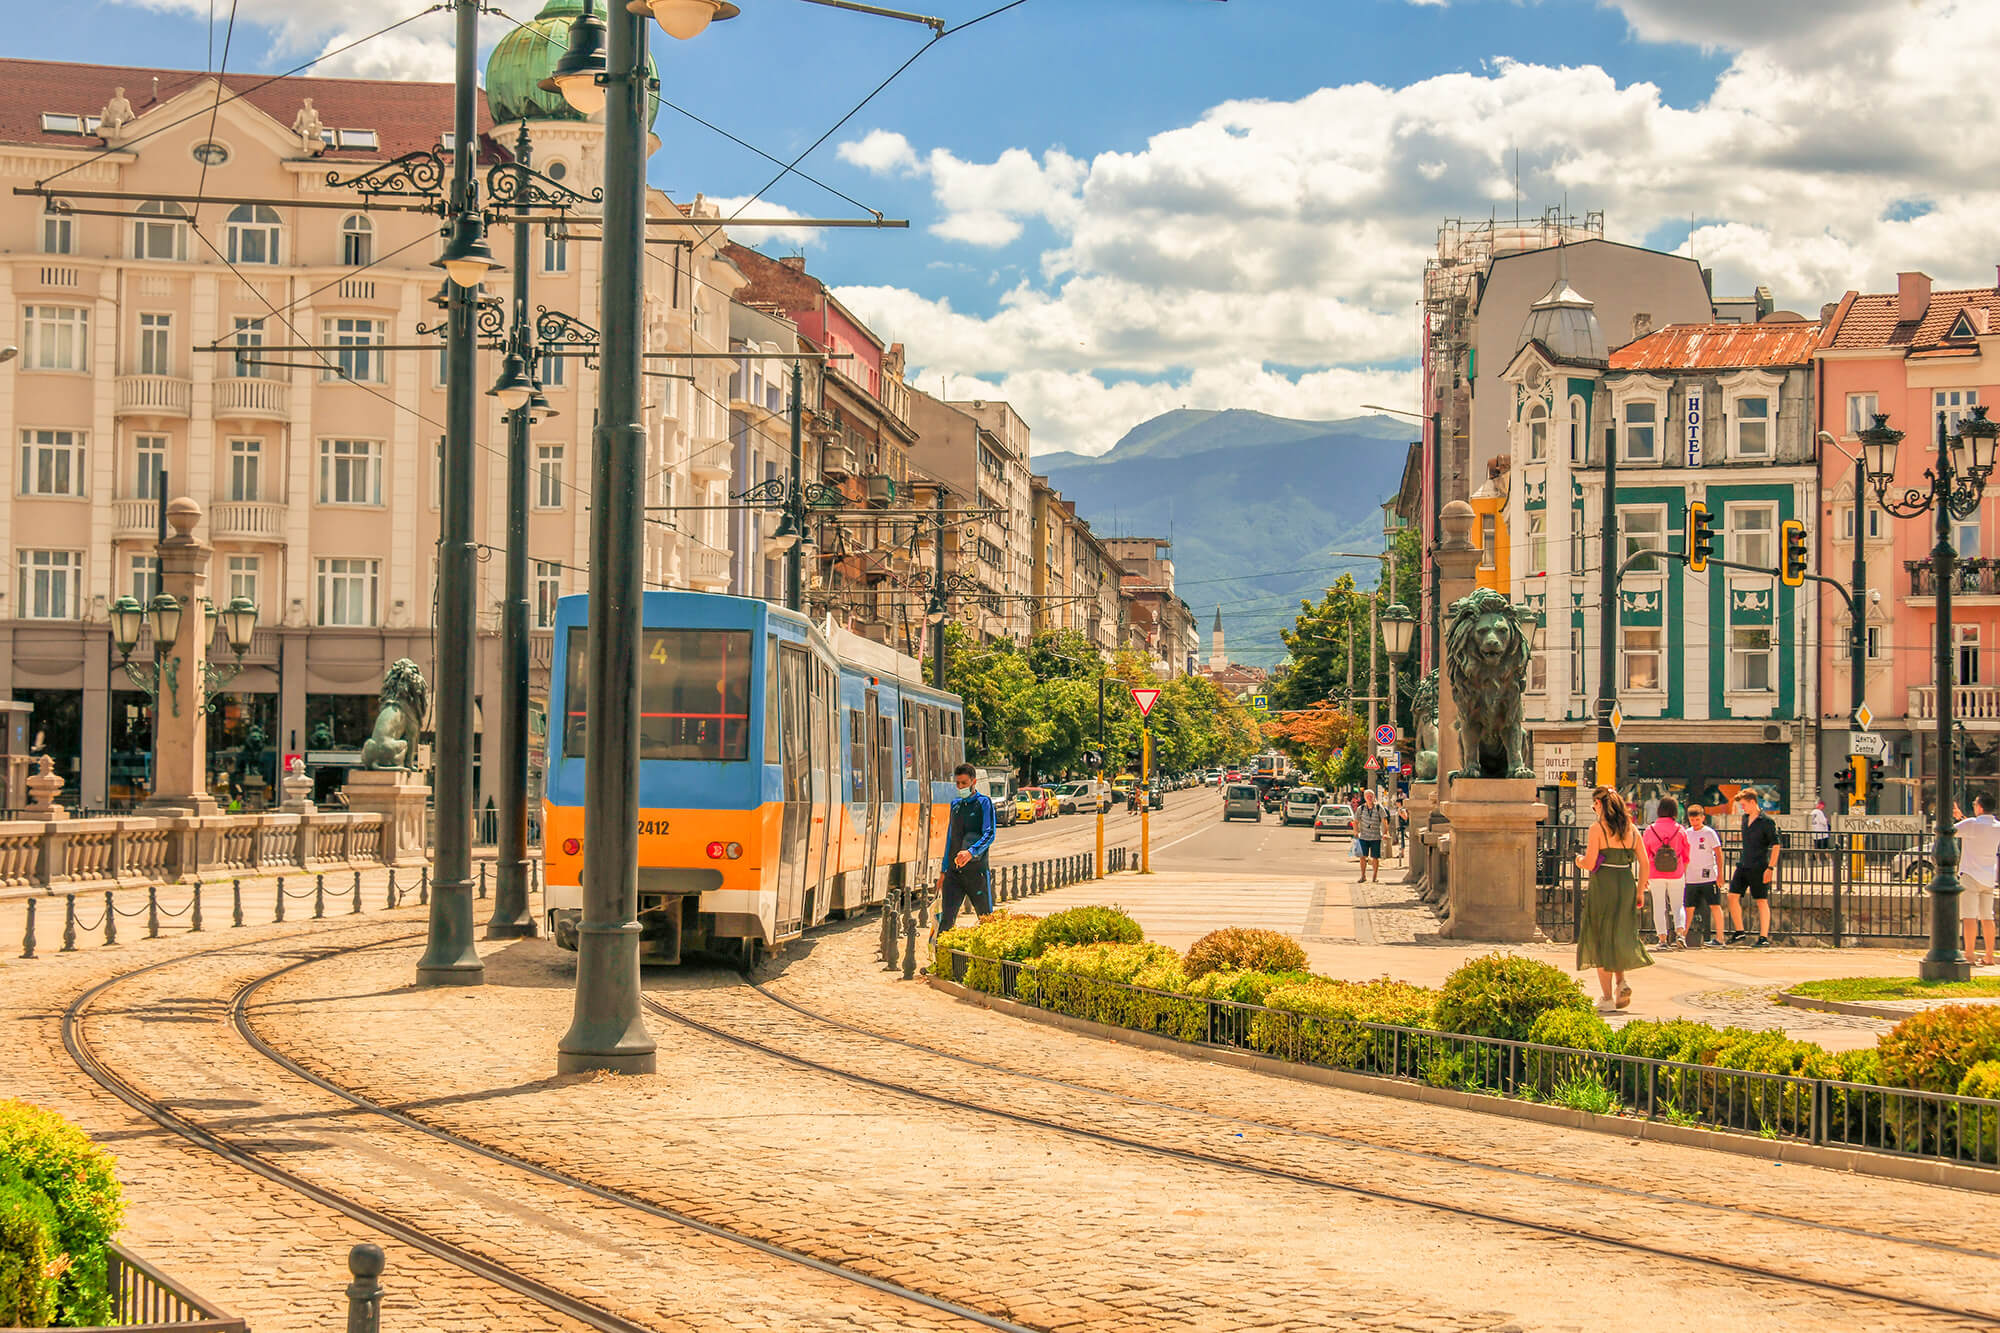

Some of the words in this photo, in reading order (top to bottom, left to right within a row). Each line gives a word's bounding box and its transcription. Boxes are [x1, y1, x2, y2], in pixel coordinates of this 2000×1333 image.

[1688, 397, 1700, 467] HOTEL
[650, 639, 667, 665] 4
[1856, 744, 1874, 753] Centre
[1546, 758, 1569, 767] OUTLET
[638, 820, 669, 835] 2412
